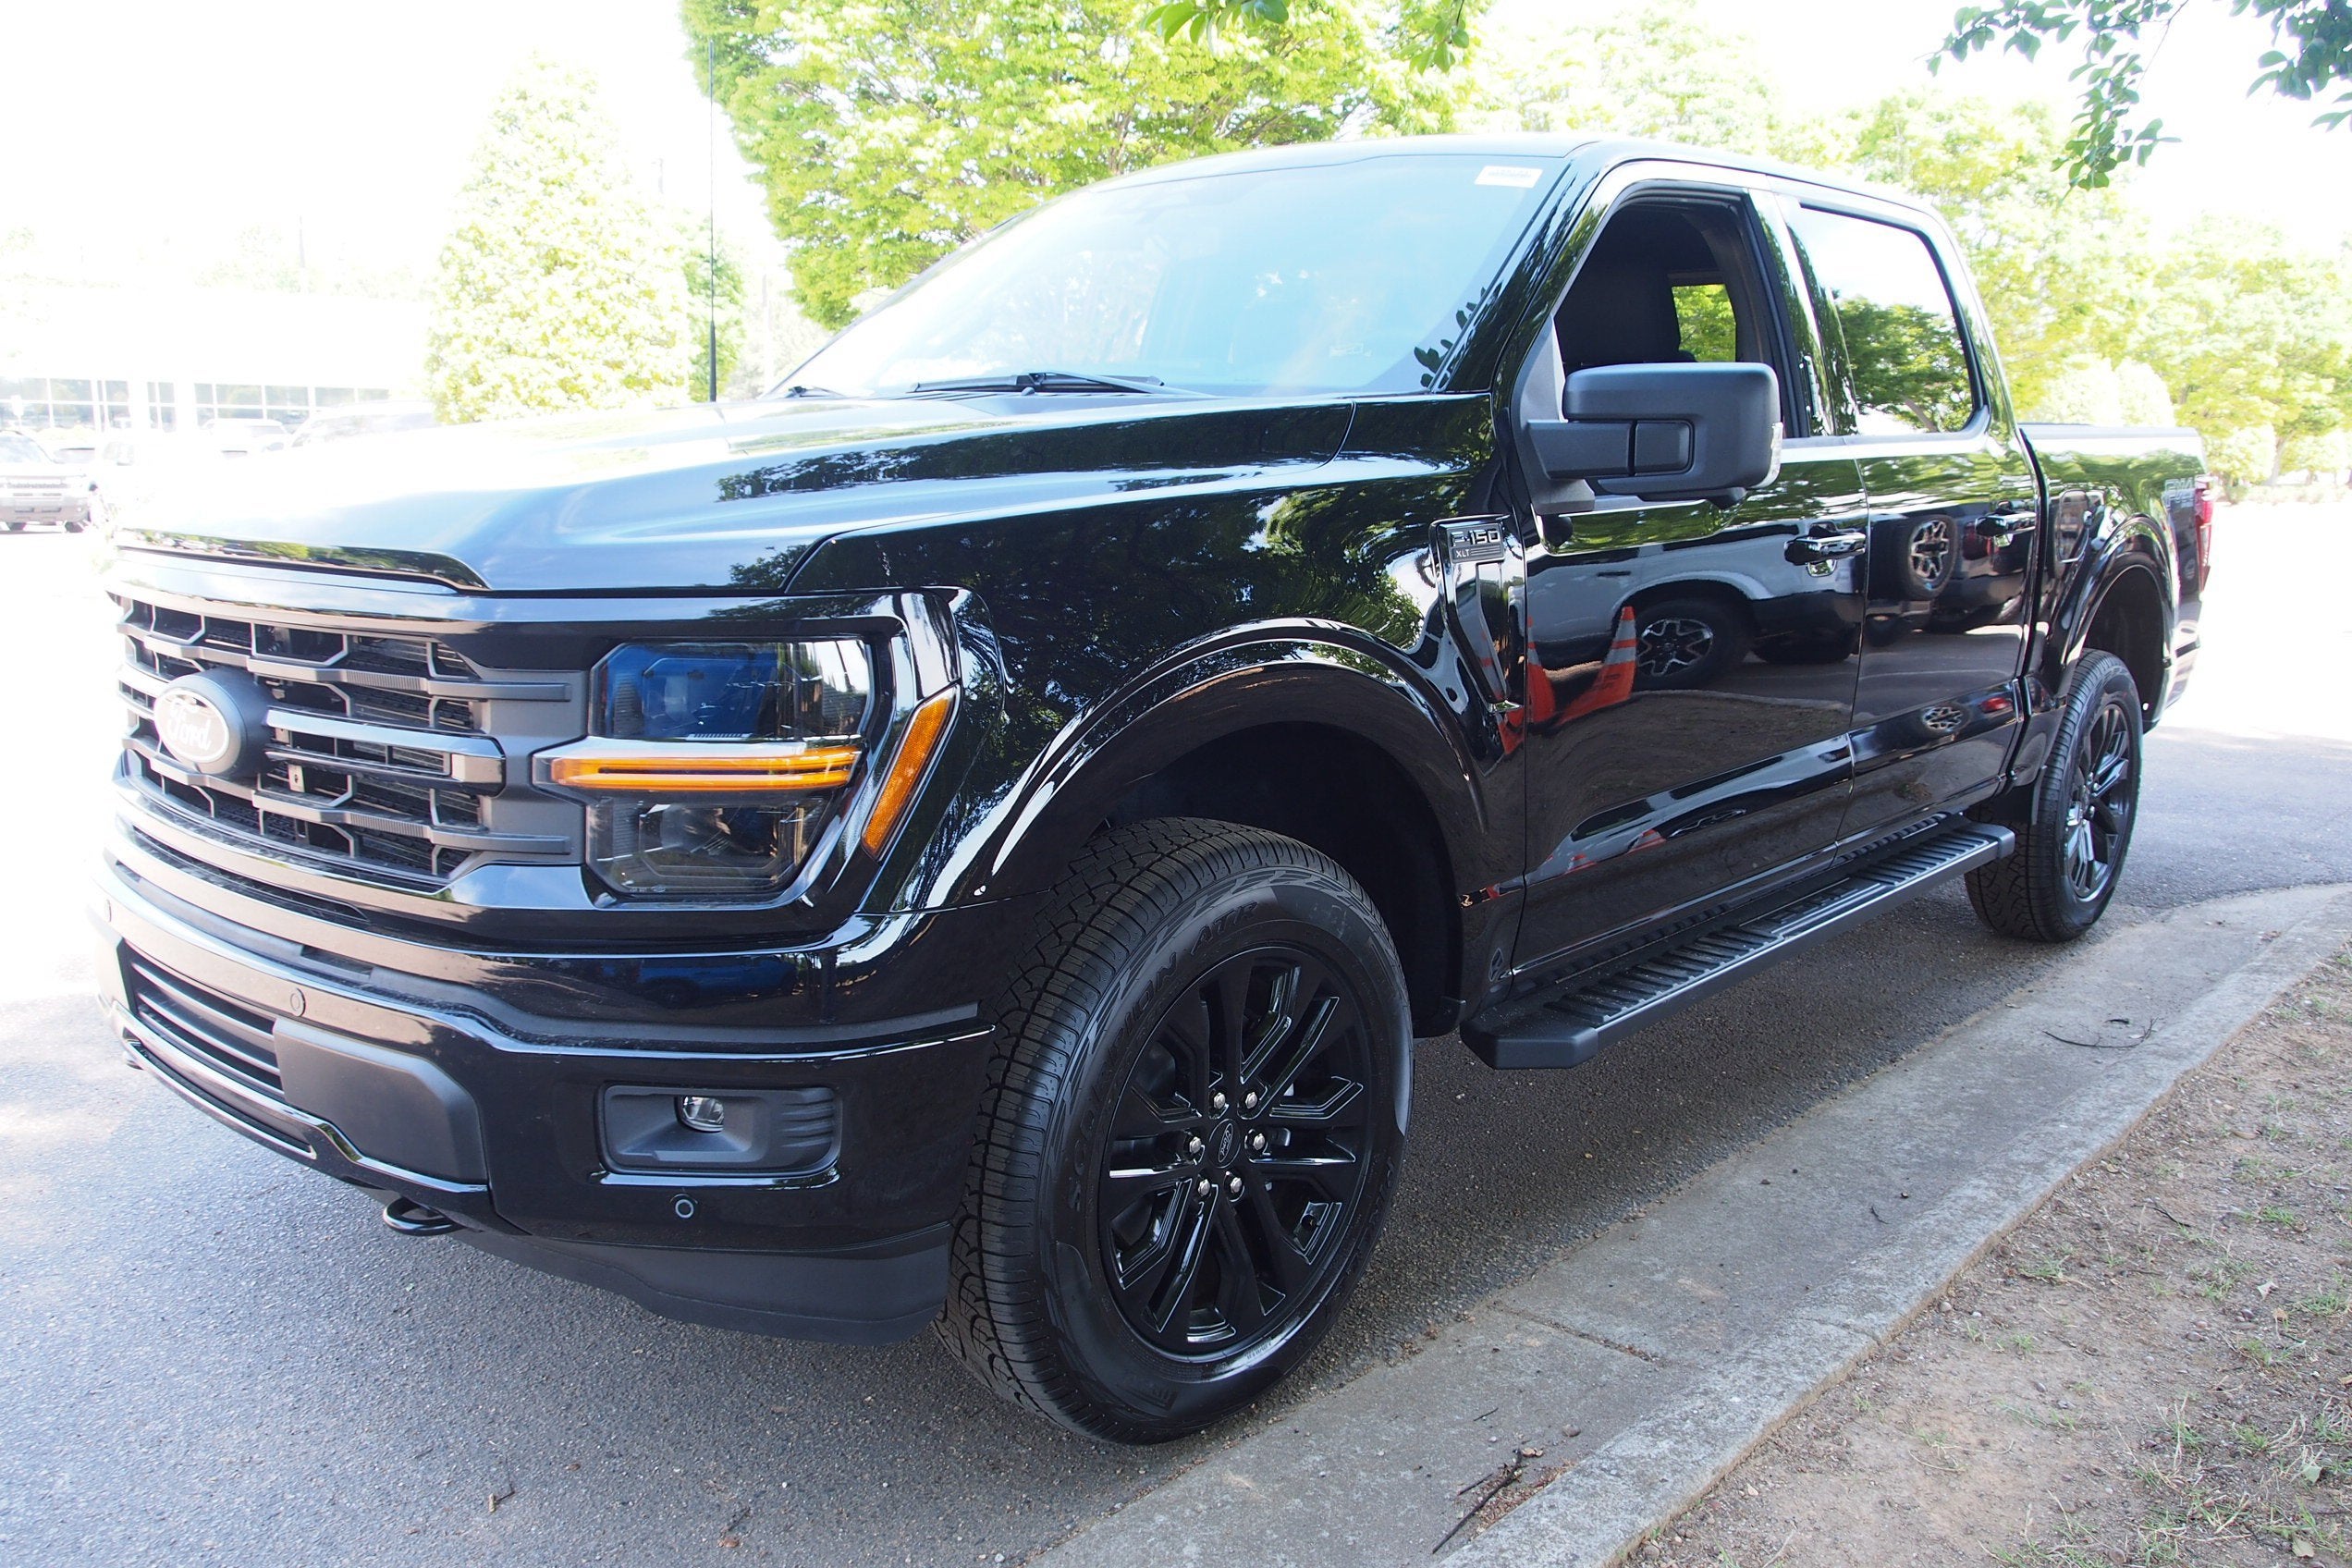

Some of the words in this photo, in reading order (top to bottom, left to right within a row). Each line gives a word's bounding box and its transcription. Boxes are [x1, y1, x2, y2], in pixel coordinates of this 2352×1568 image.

[1451, 528, 1501, 547] F-150
[1455, 549, 1471, 557] XLT
[166, 697, 213, 751] Ford
